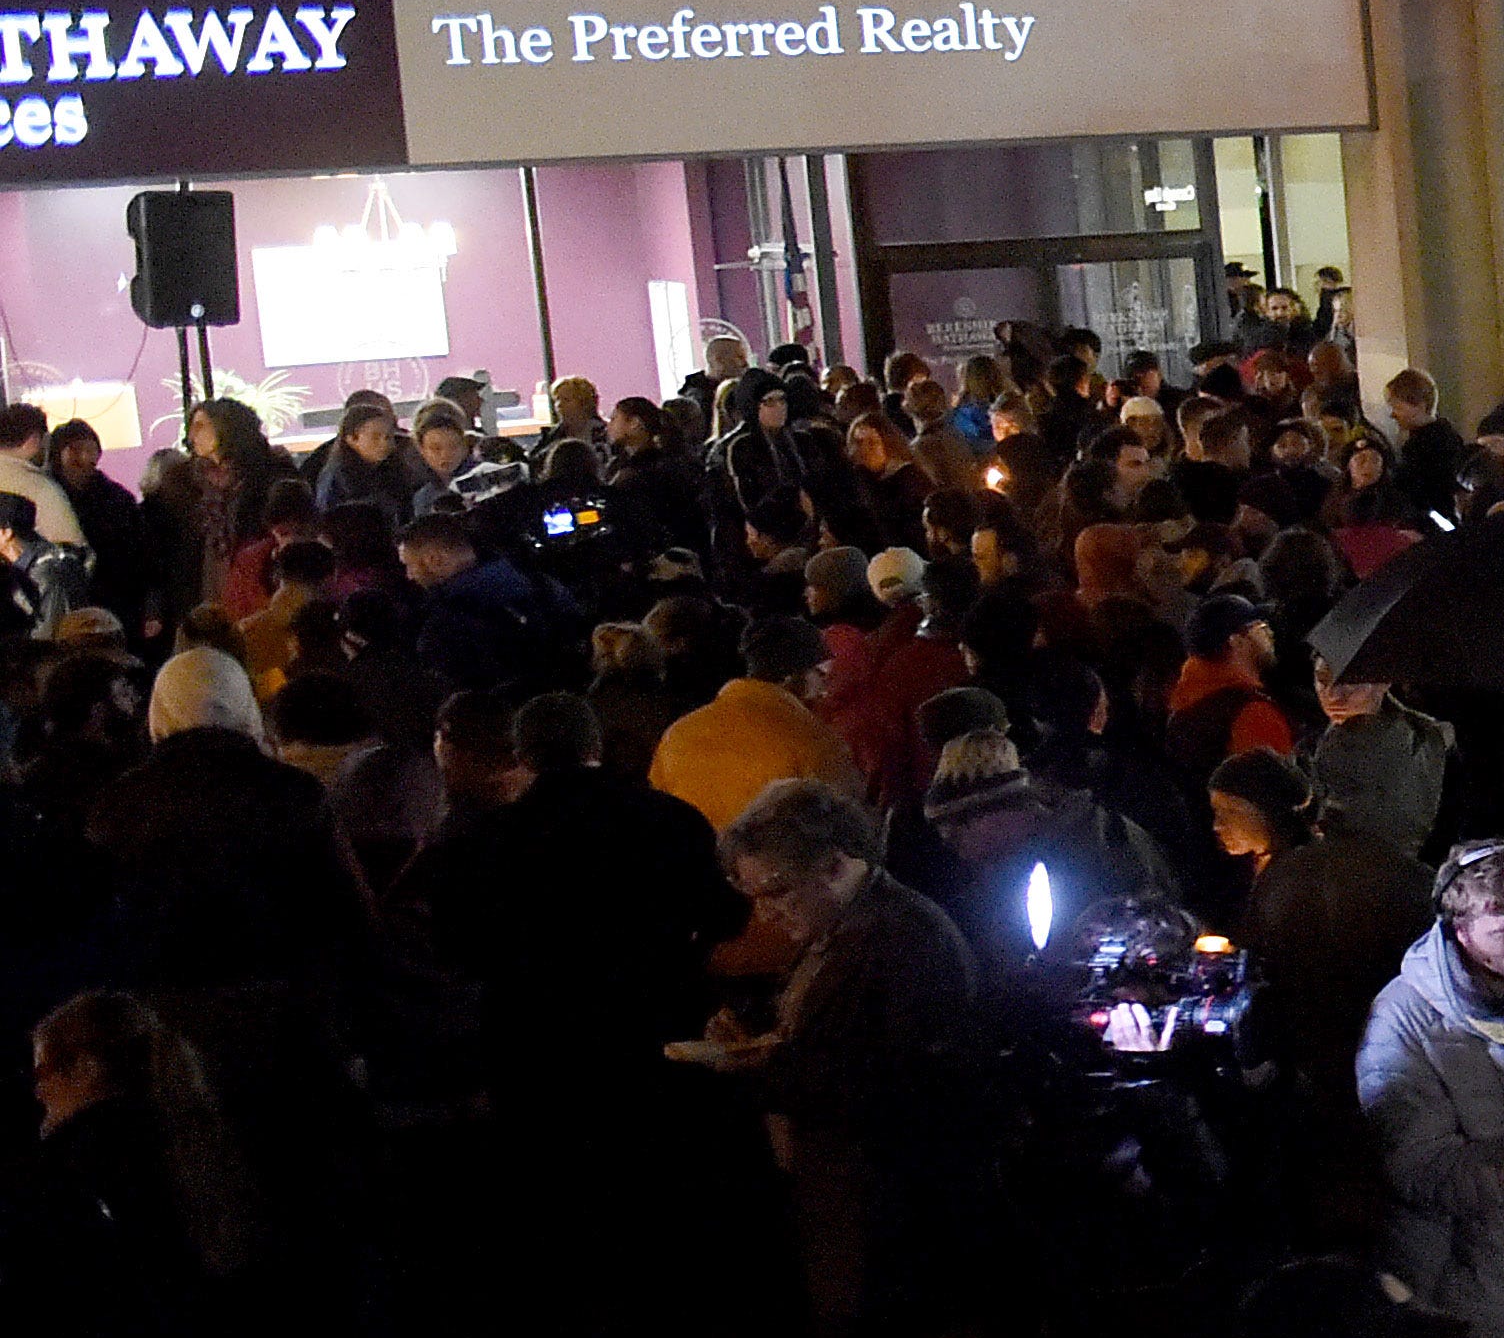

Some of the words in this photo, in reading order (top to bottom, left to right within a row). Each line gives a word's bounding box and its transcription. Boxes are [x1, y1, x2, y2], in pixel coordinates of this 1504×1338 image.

[432, 12, 554, 65] The
[567, 7, 844, 61] Preferred
[856, 2, 1036, 61] Realty
